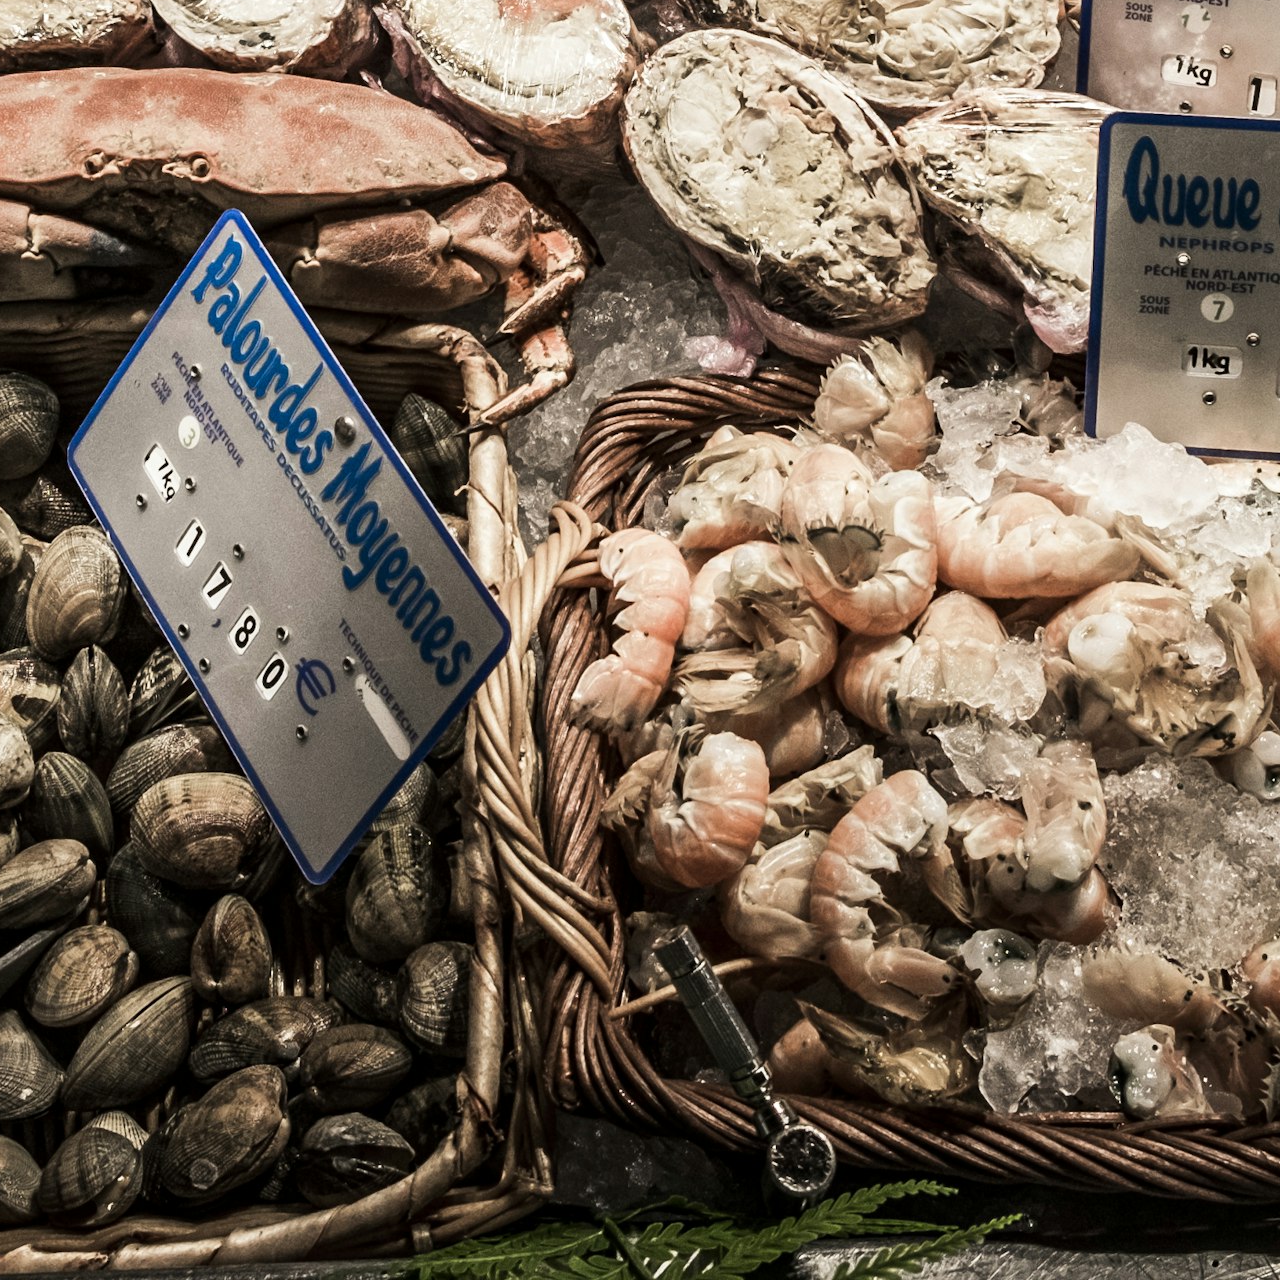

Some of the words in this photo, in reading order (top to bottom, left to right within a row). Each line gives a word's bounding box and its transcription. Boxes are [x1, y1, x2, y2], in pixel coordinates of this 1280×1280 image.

[1125, 12, 1152, 23] ZONE
[1126, 2, 1153, 13] SOUS
[1176, 54, 1212, 87] 1kg
[1123, 135, 1262, 232] Queue
[1159, 236, 1274, 254] NEPHROPS
[1144, 264, 1188, 278] PÊCHE
[1192, 268, 1209, 279] EN
[1186, 280, 1256, 294] NORD-EST
[1139, 305, 1170, 315] ZONE
[1140, 295, 1170, 306] SOUS
[1212, 300, 1225, 320] 7
[1188, 346, 1230, 375] 1kg
[150, 382, 168, 406] ZONE
[183, 391, 219, 445] NORD-EST
[191, 384, 204, 402] EN
[200, 397, 244, 469] ATLANTIQUE
[183, 428, 196, 447] 3
[189, 234, 336, 477] Palourdes
[321, 441, 474, 689] Moyennes
[220, 362, 277, 454] RUDITAPES
[276, 451, 348, 561] DECUSSATUS
[158, 458, 176, 503] 1kg
[338, 618, 382, 687] TECHNIQUE
[380, 685, 394, 705] DE
[391, 701, 420, 746] PÊCHE
